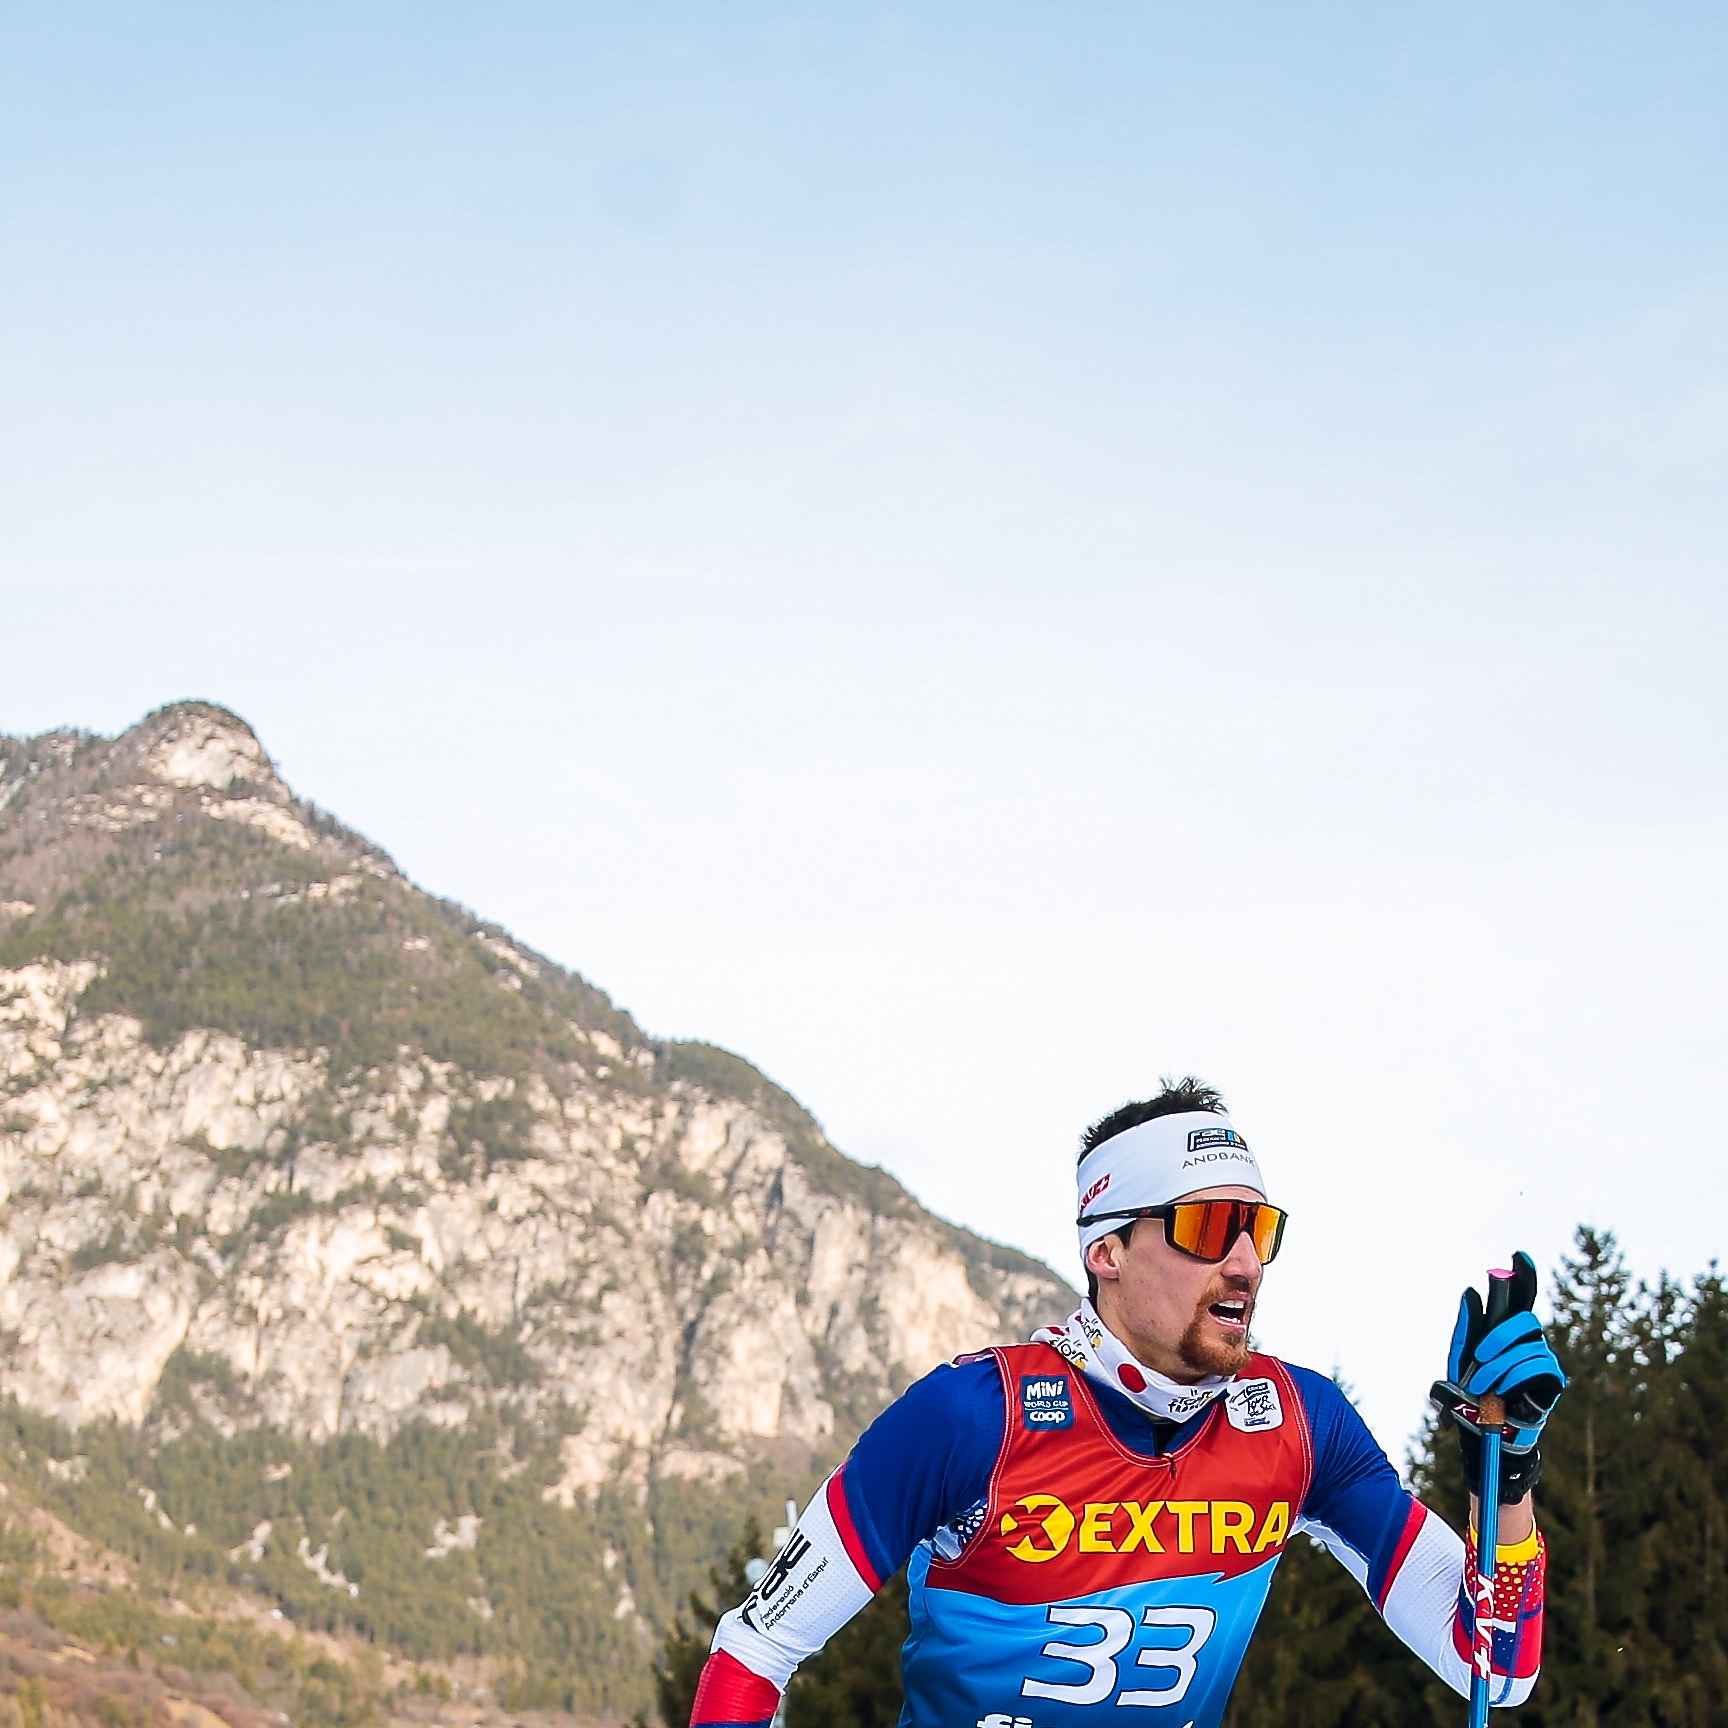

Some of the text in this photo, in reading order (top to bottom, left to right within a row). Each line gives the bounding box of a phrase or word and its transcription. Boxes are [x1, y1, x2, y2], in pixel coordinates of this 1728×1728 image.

[1024, 1400, 1069, 1409] WORLD CUP
[1079, 1501, 1290, 1554] EXTRA
[1021, 1606, 1216, 1706] 33
